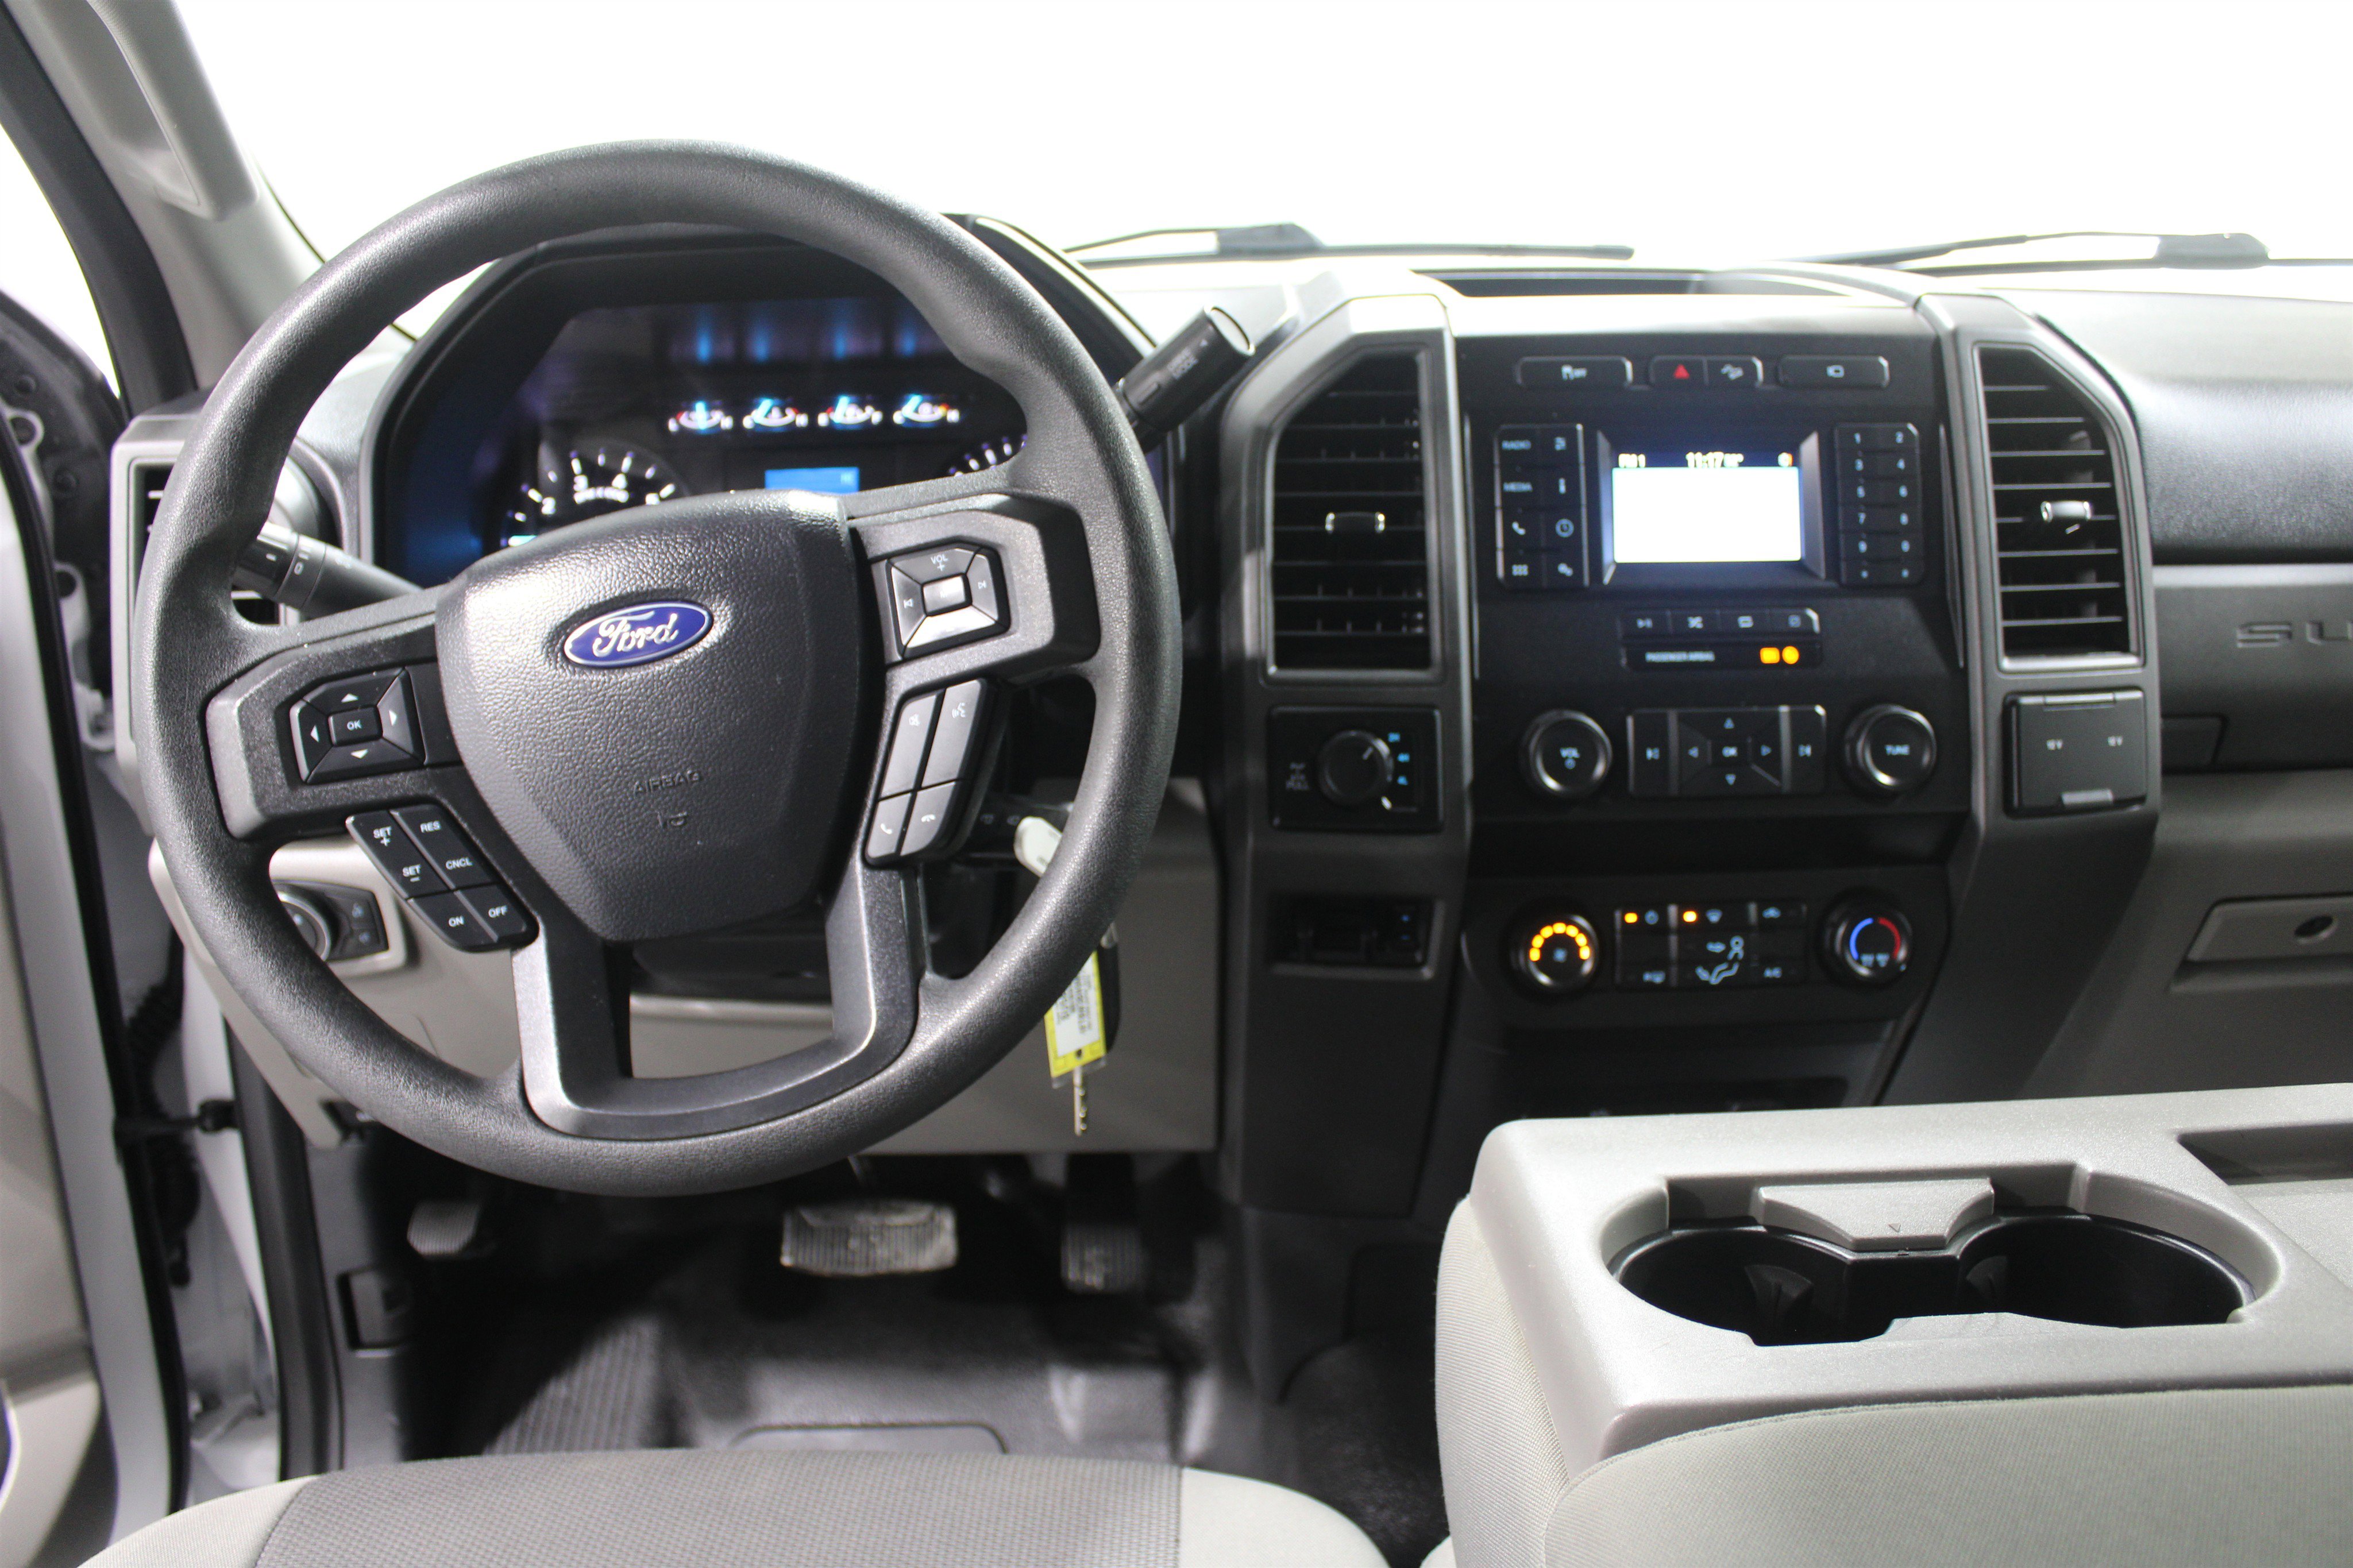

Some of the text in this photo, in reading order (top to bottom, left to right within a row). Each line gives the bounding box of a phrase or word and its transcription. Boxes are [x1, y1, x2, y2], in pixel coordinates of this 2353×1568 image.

[930, 554, 948, 565] VOL
[592, 611, 679, 657] Ford
[347, 719, 362, 731] OK
[634, 770, 703, 794] AIRBAG
[373, 826, 392, 839] SET
[420, 820, 441, 833] RES
[446, 857, 473, 870] CNCL
[402, 864, 421, 877] SET
[488, 905, 508, 918] OFF
[448, 916, 465, 927] ON
